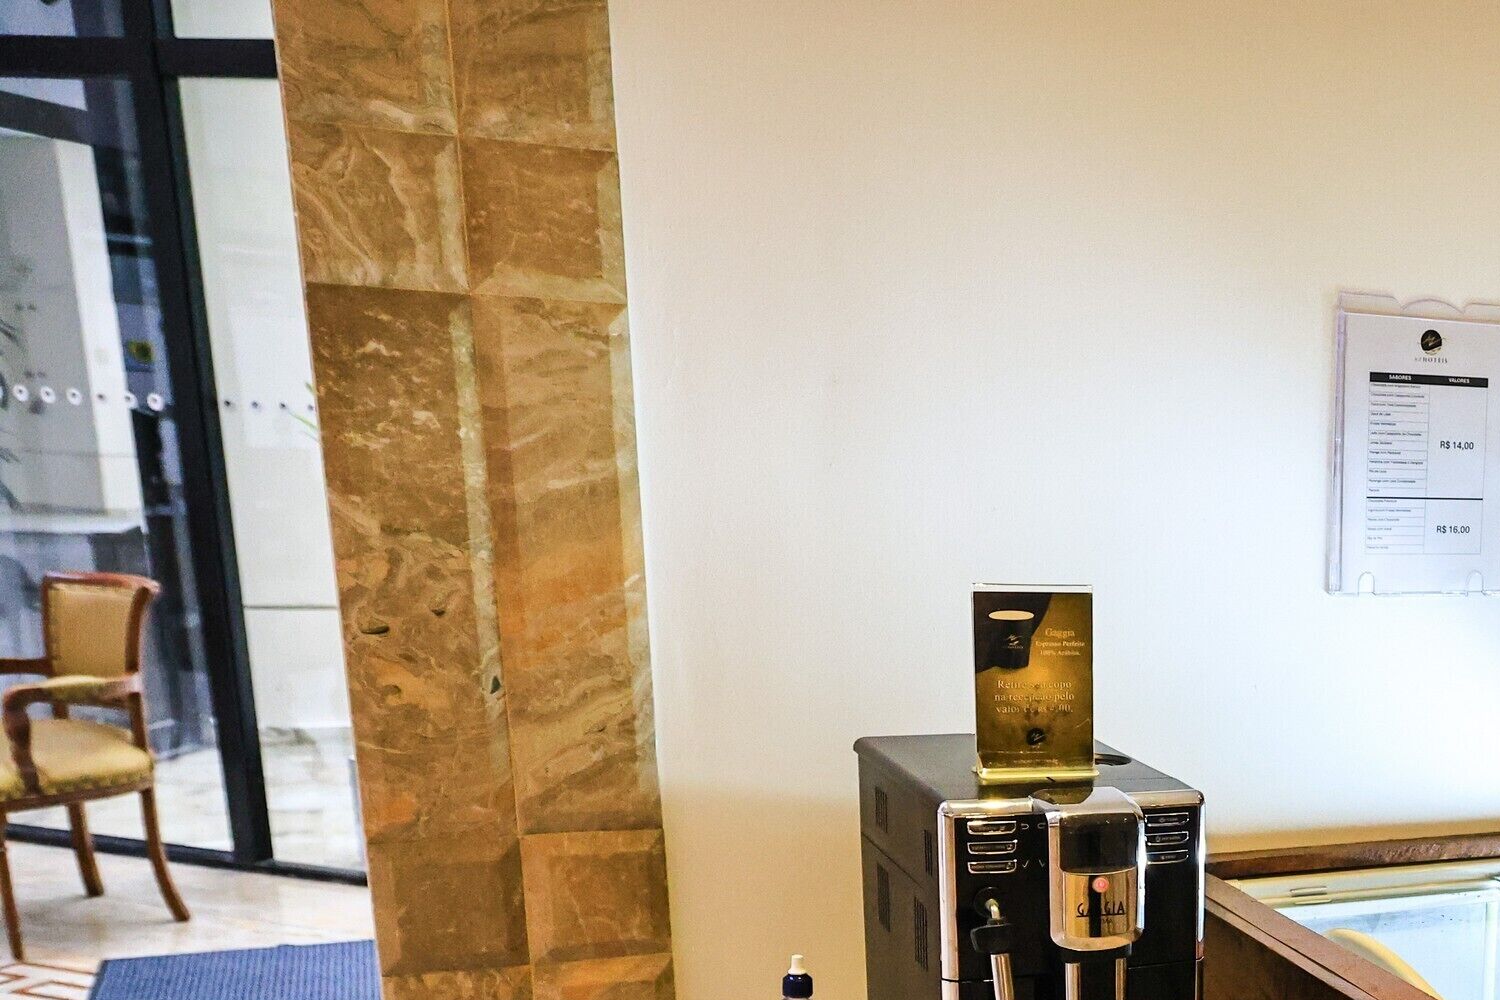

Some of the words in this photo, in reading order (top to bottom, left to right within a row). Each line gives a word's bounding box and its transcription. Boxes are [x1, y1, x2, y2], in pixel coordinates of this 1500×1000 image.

[1440, 440, 1451, 449] R$
[1453, 441, 1474, 450] 14,00
[1436, 525, 1447, 534] R$
[1449, 525, 1470, 534] 16,00
[1049, 681, 1072, 690] copo
[1054, 691, 1075, 702] pelo
